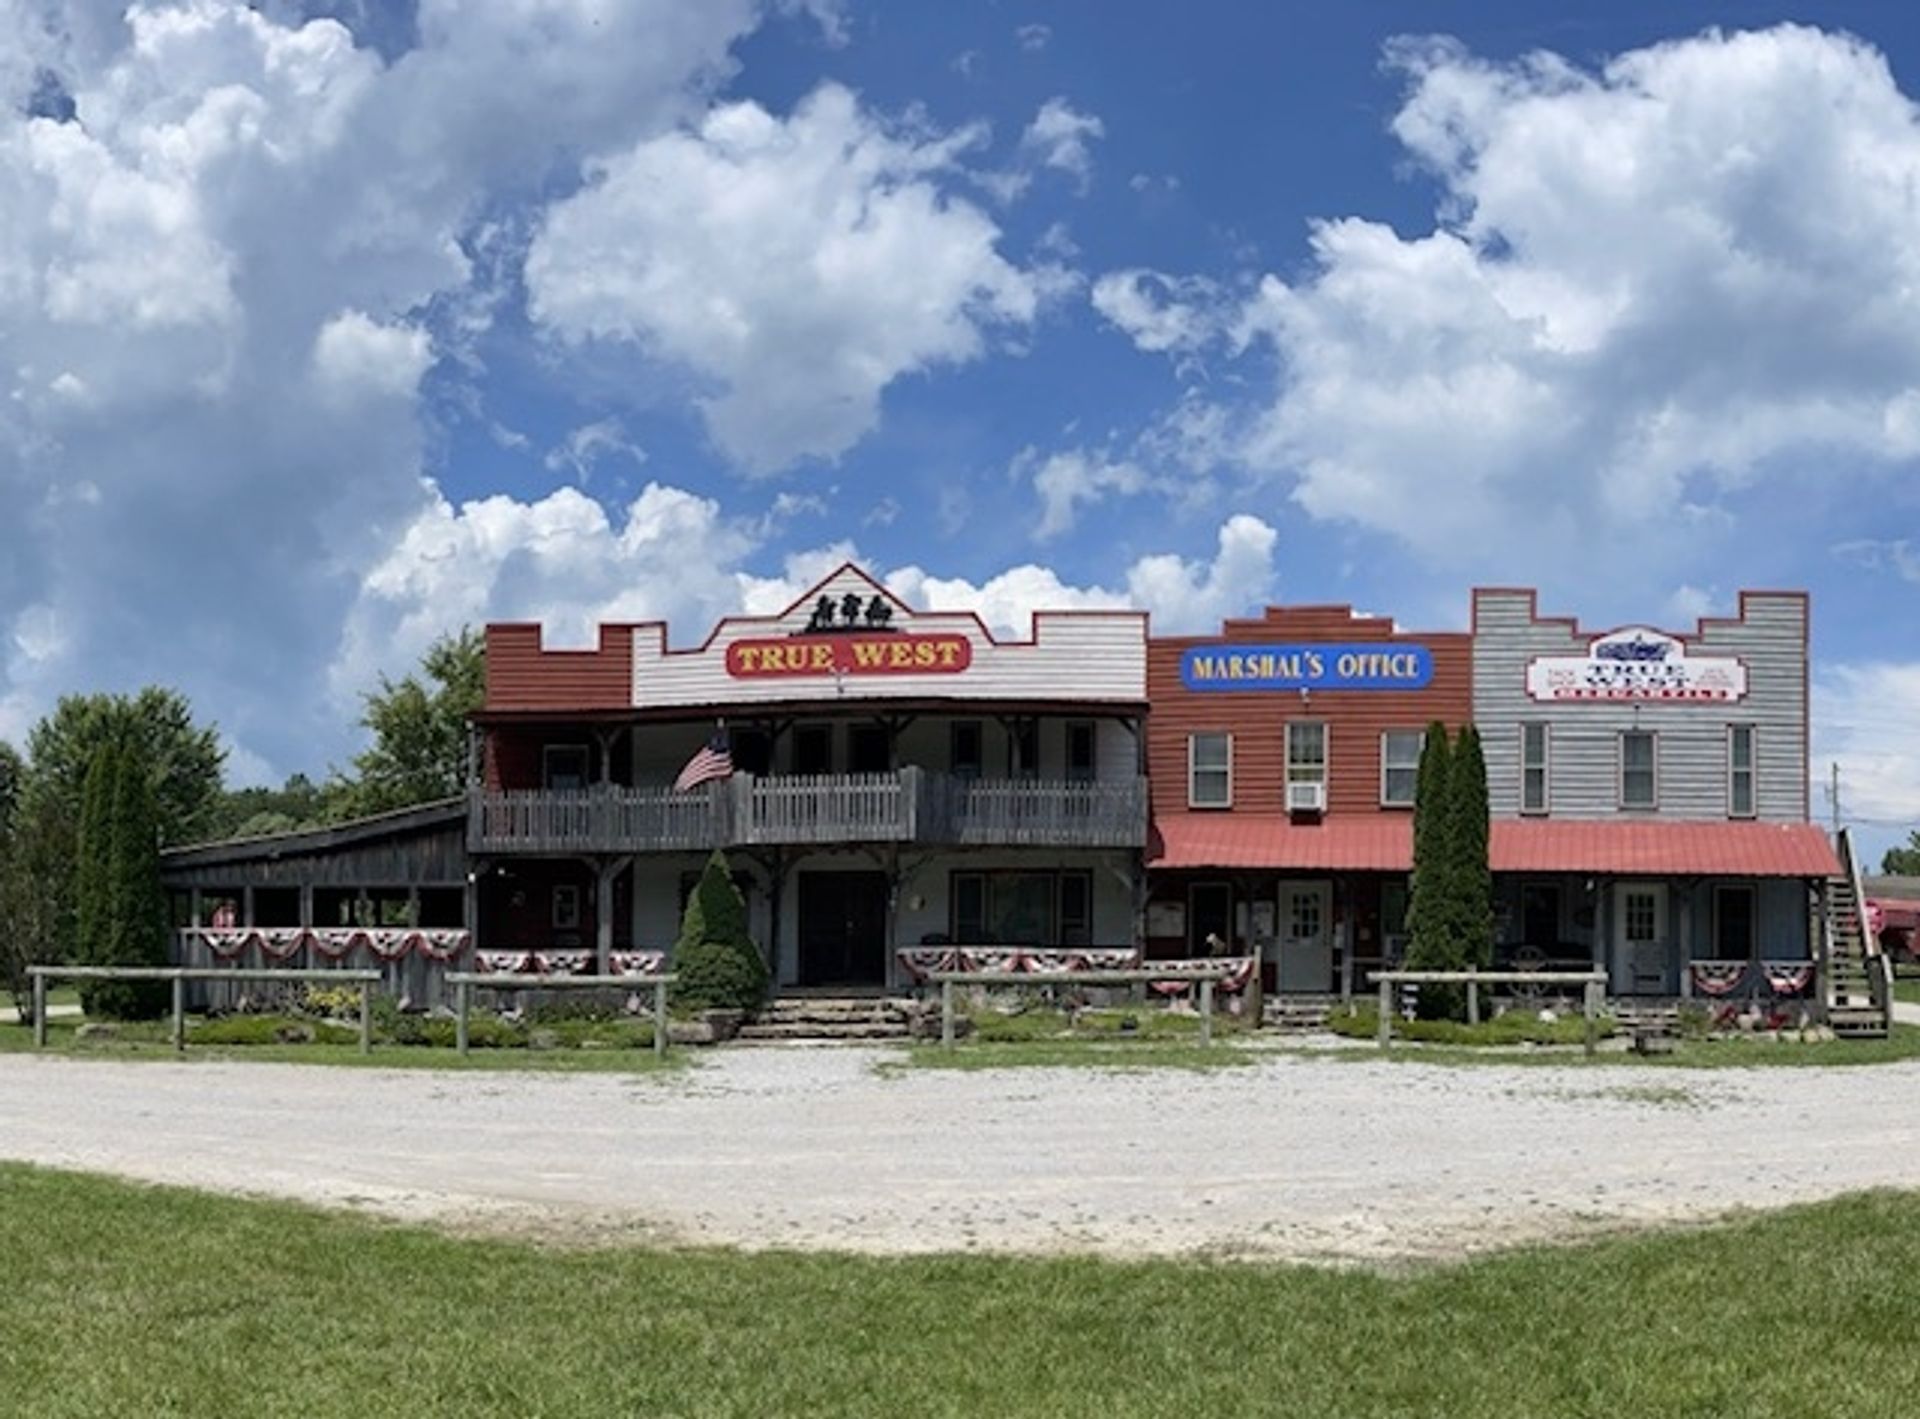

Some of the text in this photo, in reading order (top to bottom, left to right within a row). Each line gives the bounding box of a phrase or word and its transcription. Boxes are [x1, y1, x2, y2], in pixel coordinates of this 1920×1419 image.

[737, 640, 961, 672] TRUE WEST
[1191, 650, 1421, 679] MARSHAL'S OFFICE
[1587, 664, 1686, 677] TRUE
[1583, 677, 1690, 688] WEST
